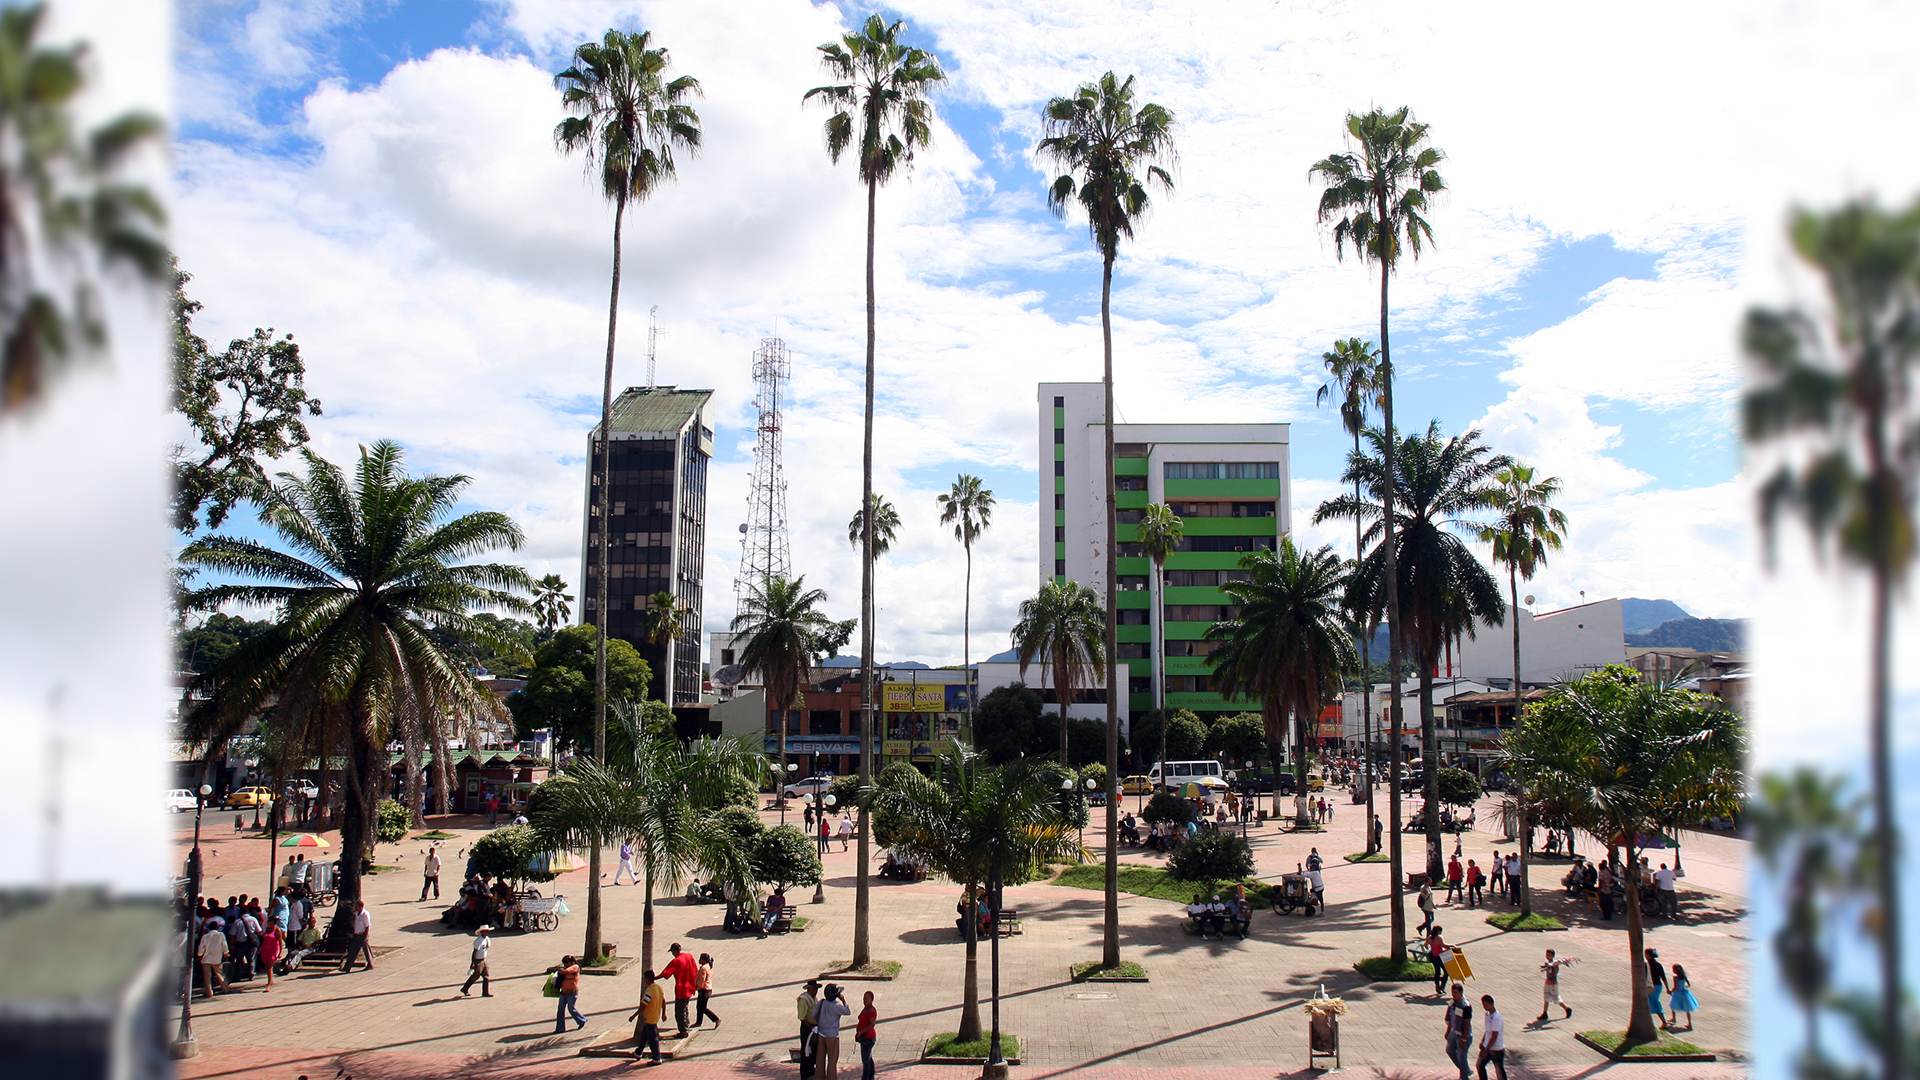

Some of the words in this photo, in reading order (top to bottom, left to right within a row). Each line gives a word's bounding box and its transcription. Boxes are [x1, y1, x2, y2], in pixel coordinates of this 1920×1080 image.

[917, 692, 943, 701] SANTA
[889, 702, 901, 710] 3B
[792, 742, 852, 752] SERVAF
